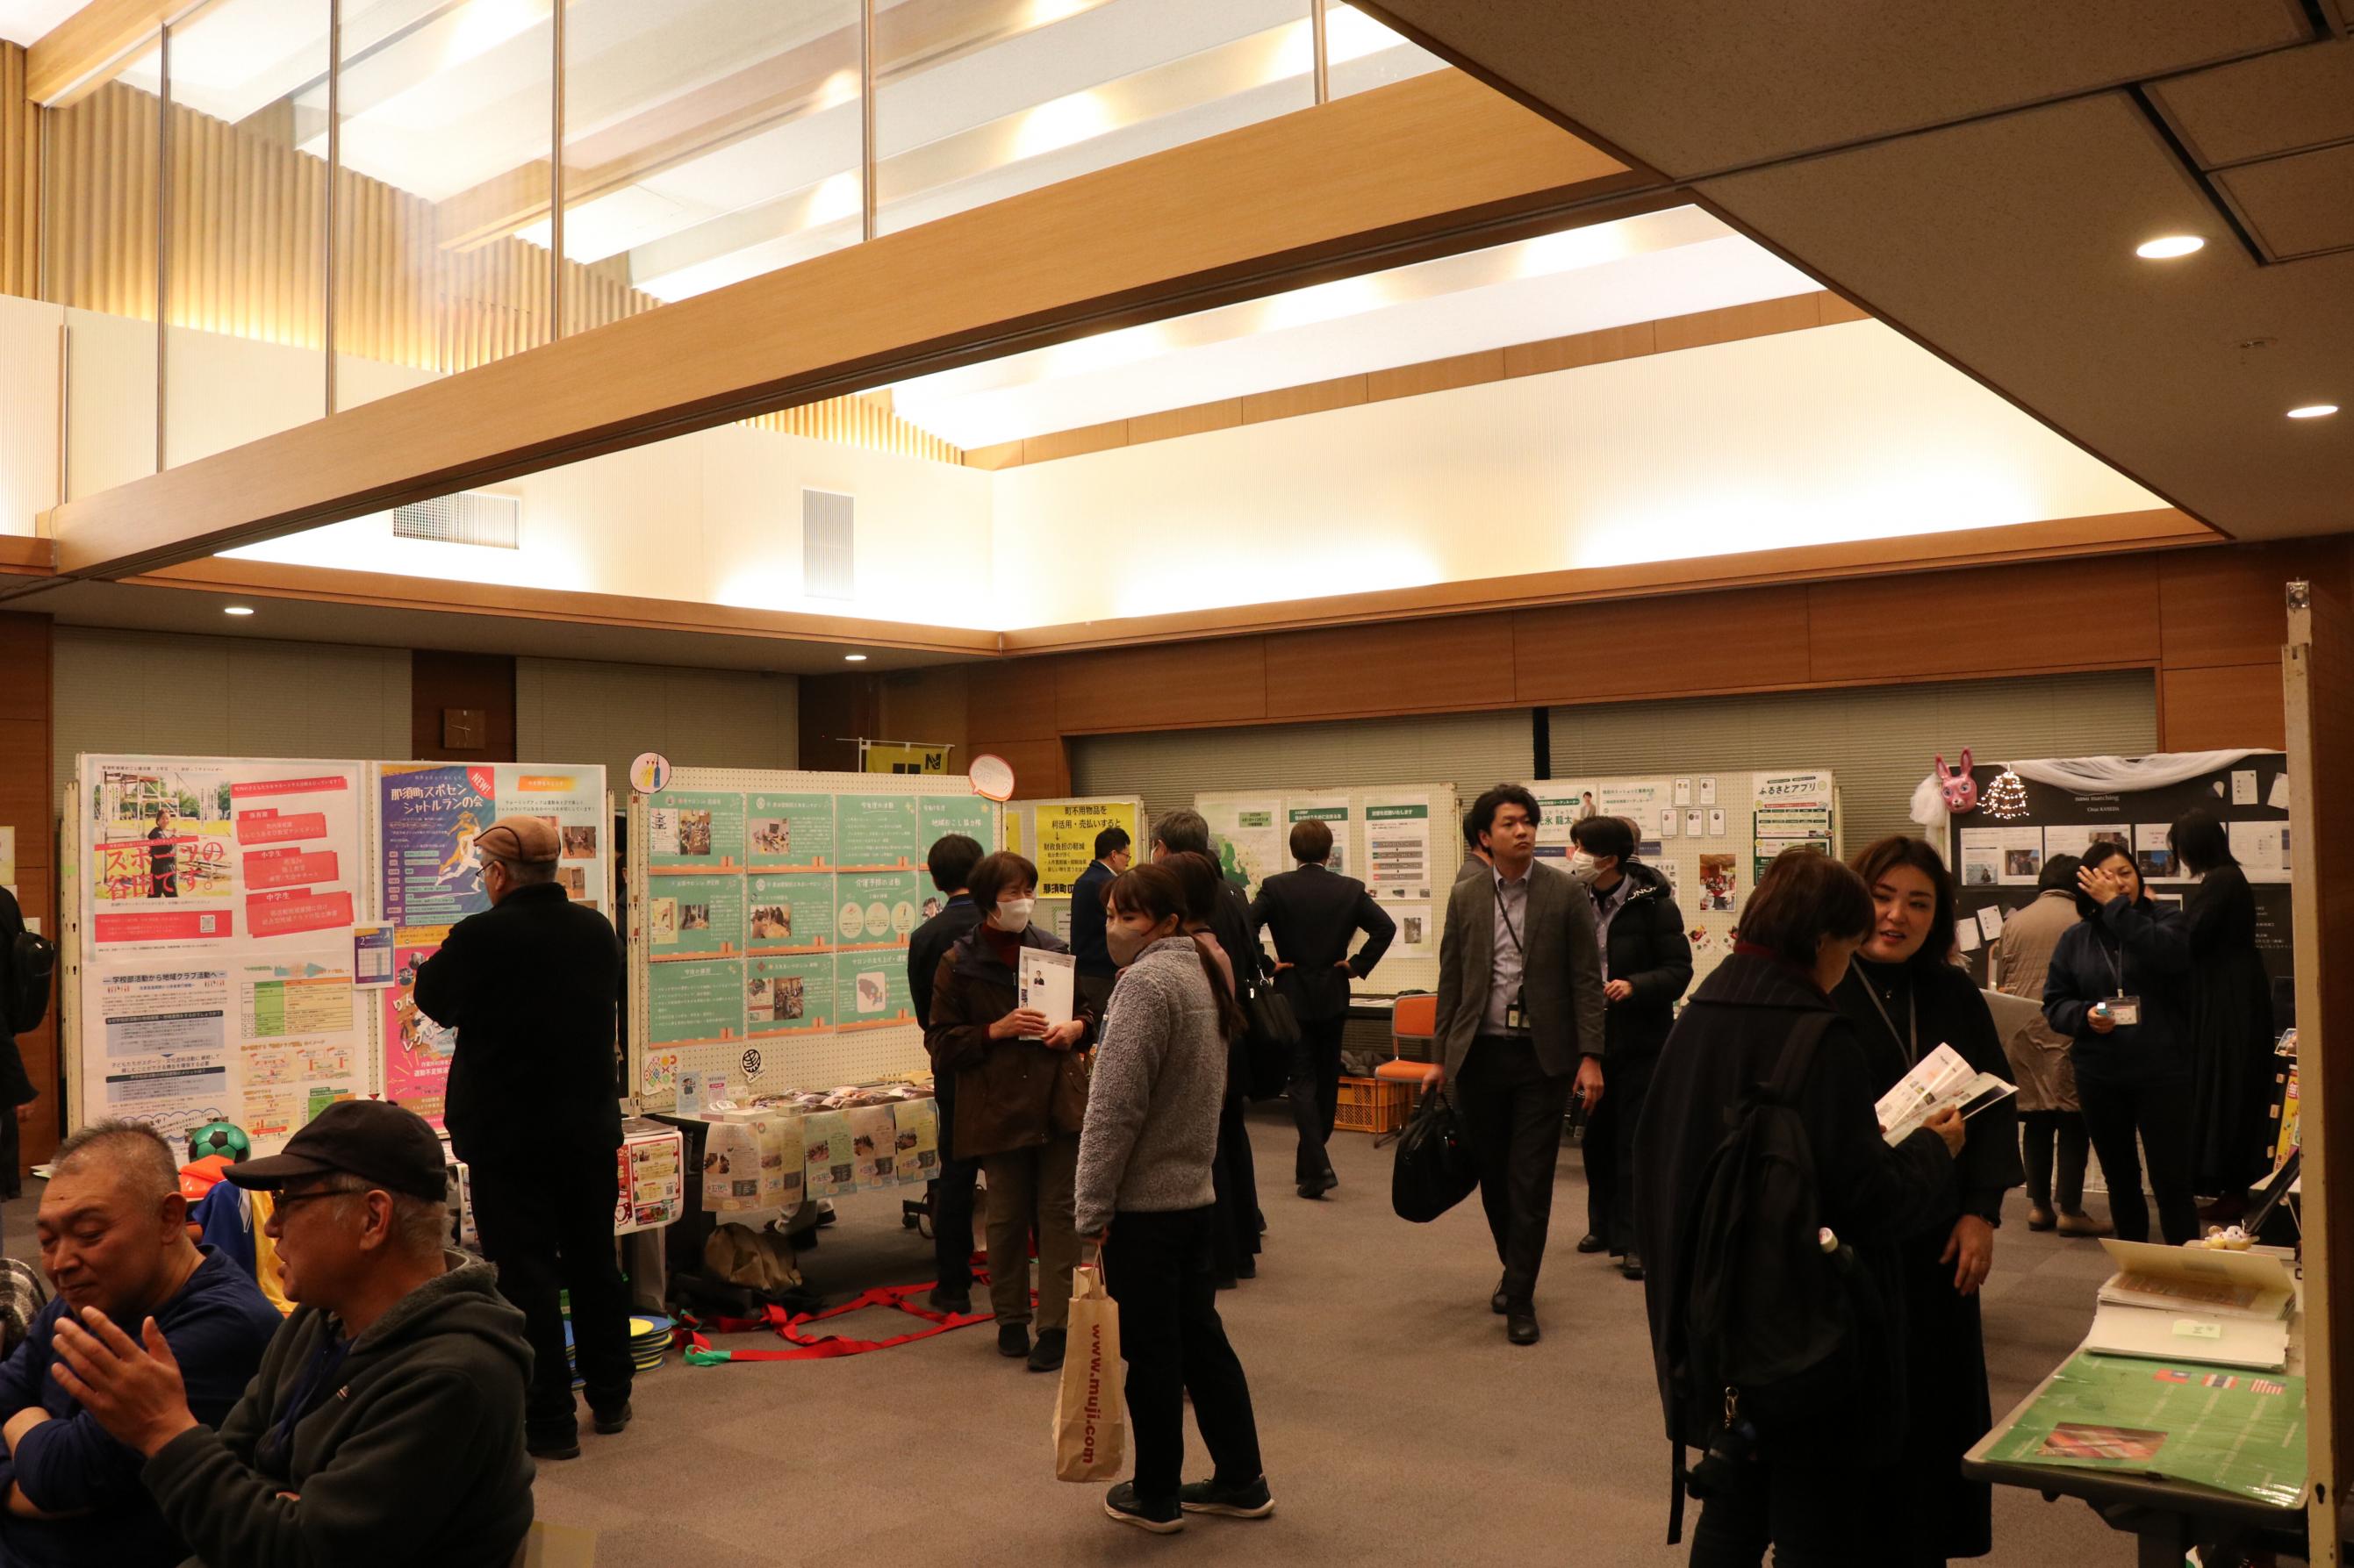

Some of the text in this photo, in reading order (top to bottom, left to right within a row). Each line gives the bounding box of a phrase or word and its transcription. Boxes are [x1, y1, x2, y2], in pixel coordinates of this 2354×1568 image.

[471, 772, 492, 794] NEW!
[1758, 782, 1817, 795] ふるさとアプリ
[391, 784, 467, 801] 那須町スポセン
[404, 797, 484, 814] シャトルランの会
[1065, 805, 1108, 815] 町不用物品を
[1051, 818, 1121, 829] 利活用・売払いすると
[1044, 842, 1085, 851] 財政負担の軽減
[106, 841, 224, 872] スポーツの
[106, 870, 212, 901] 谷田です。
[266, 891, 291, 902] 中学生
[112, 971, 217, 984] 学校部活動から地域クラブ活動へ
[1082, 1323, 1102, 1464] www.muji.com
